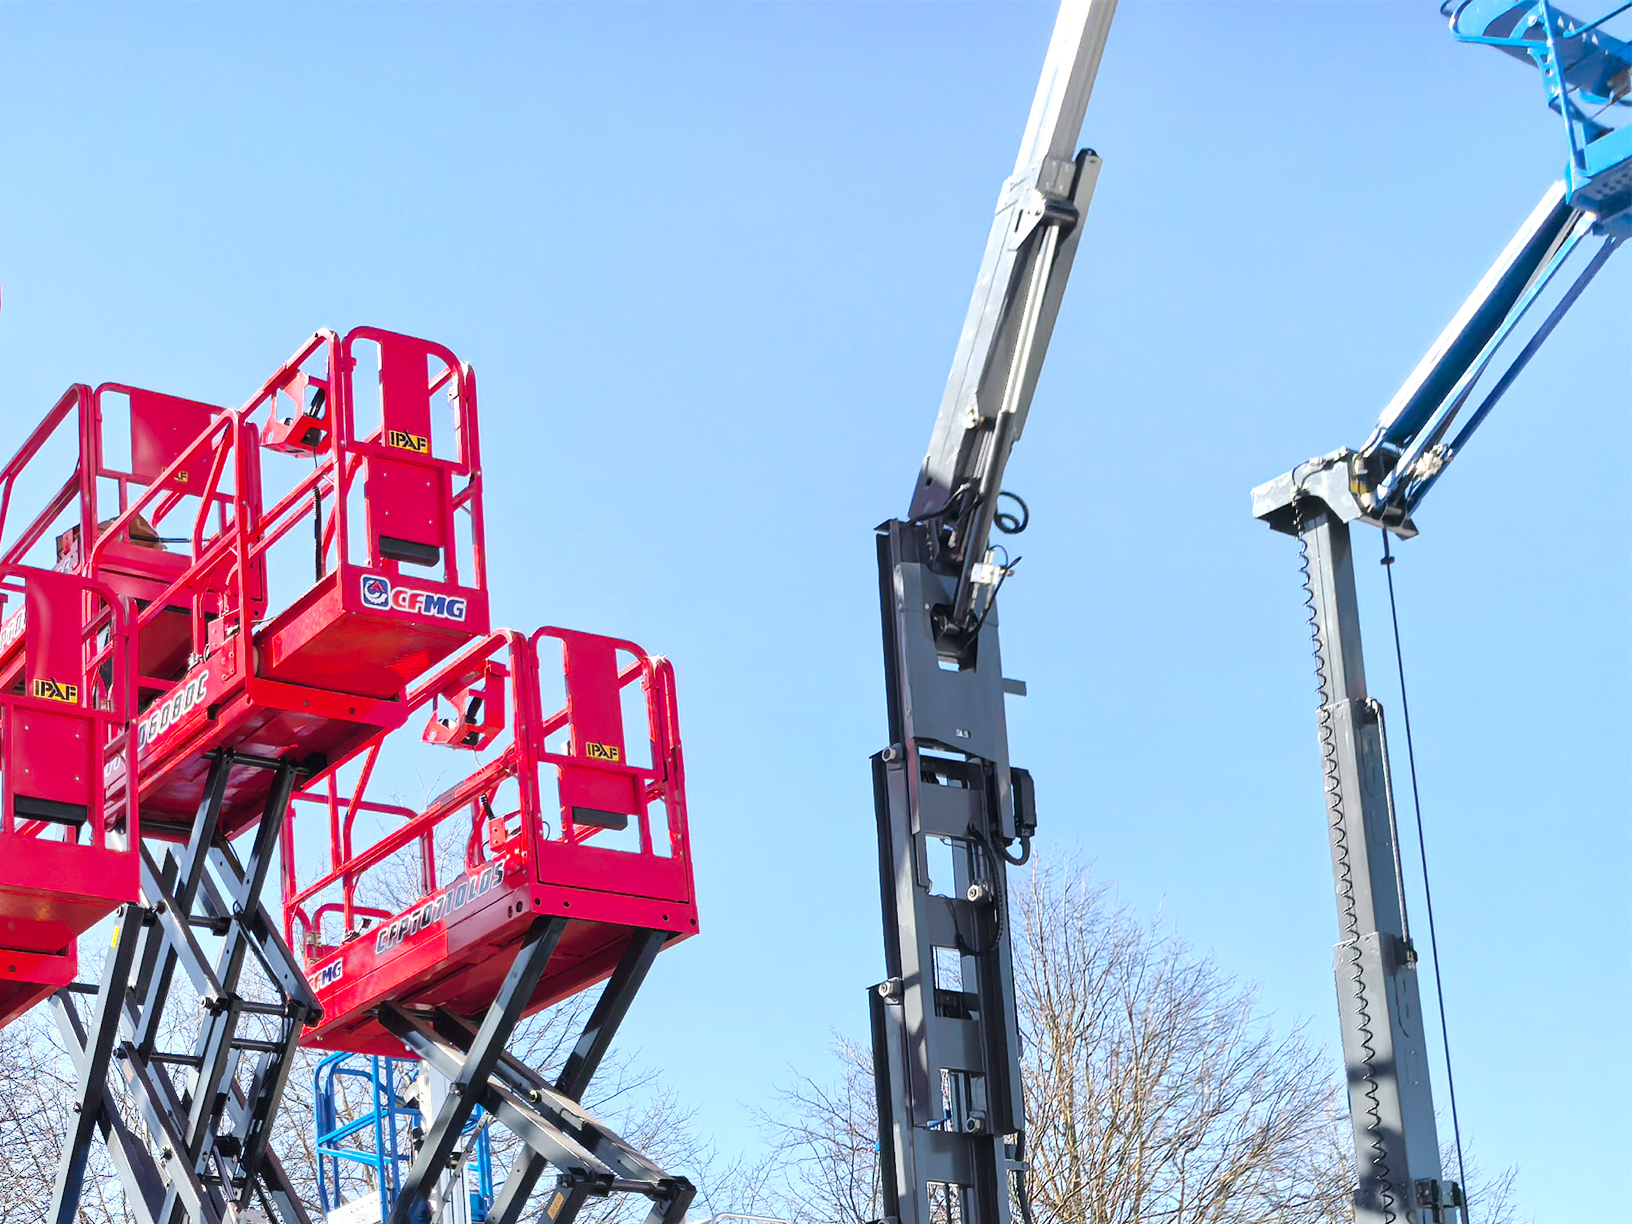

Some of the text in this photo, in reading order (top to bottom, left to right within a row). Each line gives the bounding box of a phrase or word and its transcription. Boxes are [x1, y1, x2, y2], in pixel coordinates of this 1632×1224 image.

[390, 429, 428, 451] IPAF
[391, 588, 465, 619] CFMG
[35, 677, 77, 701] IPAF
[587, 741, 618, 760] IPAF
